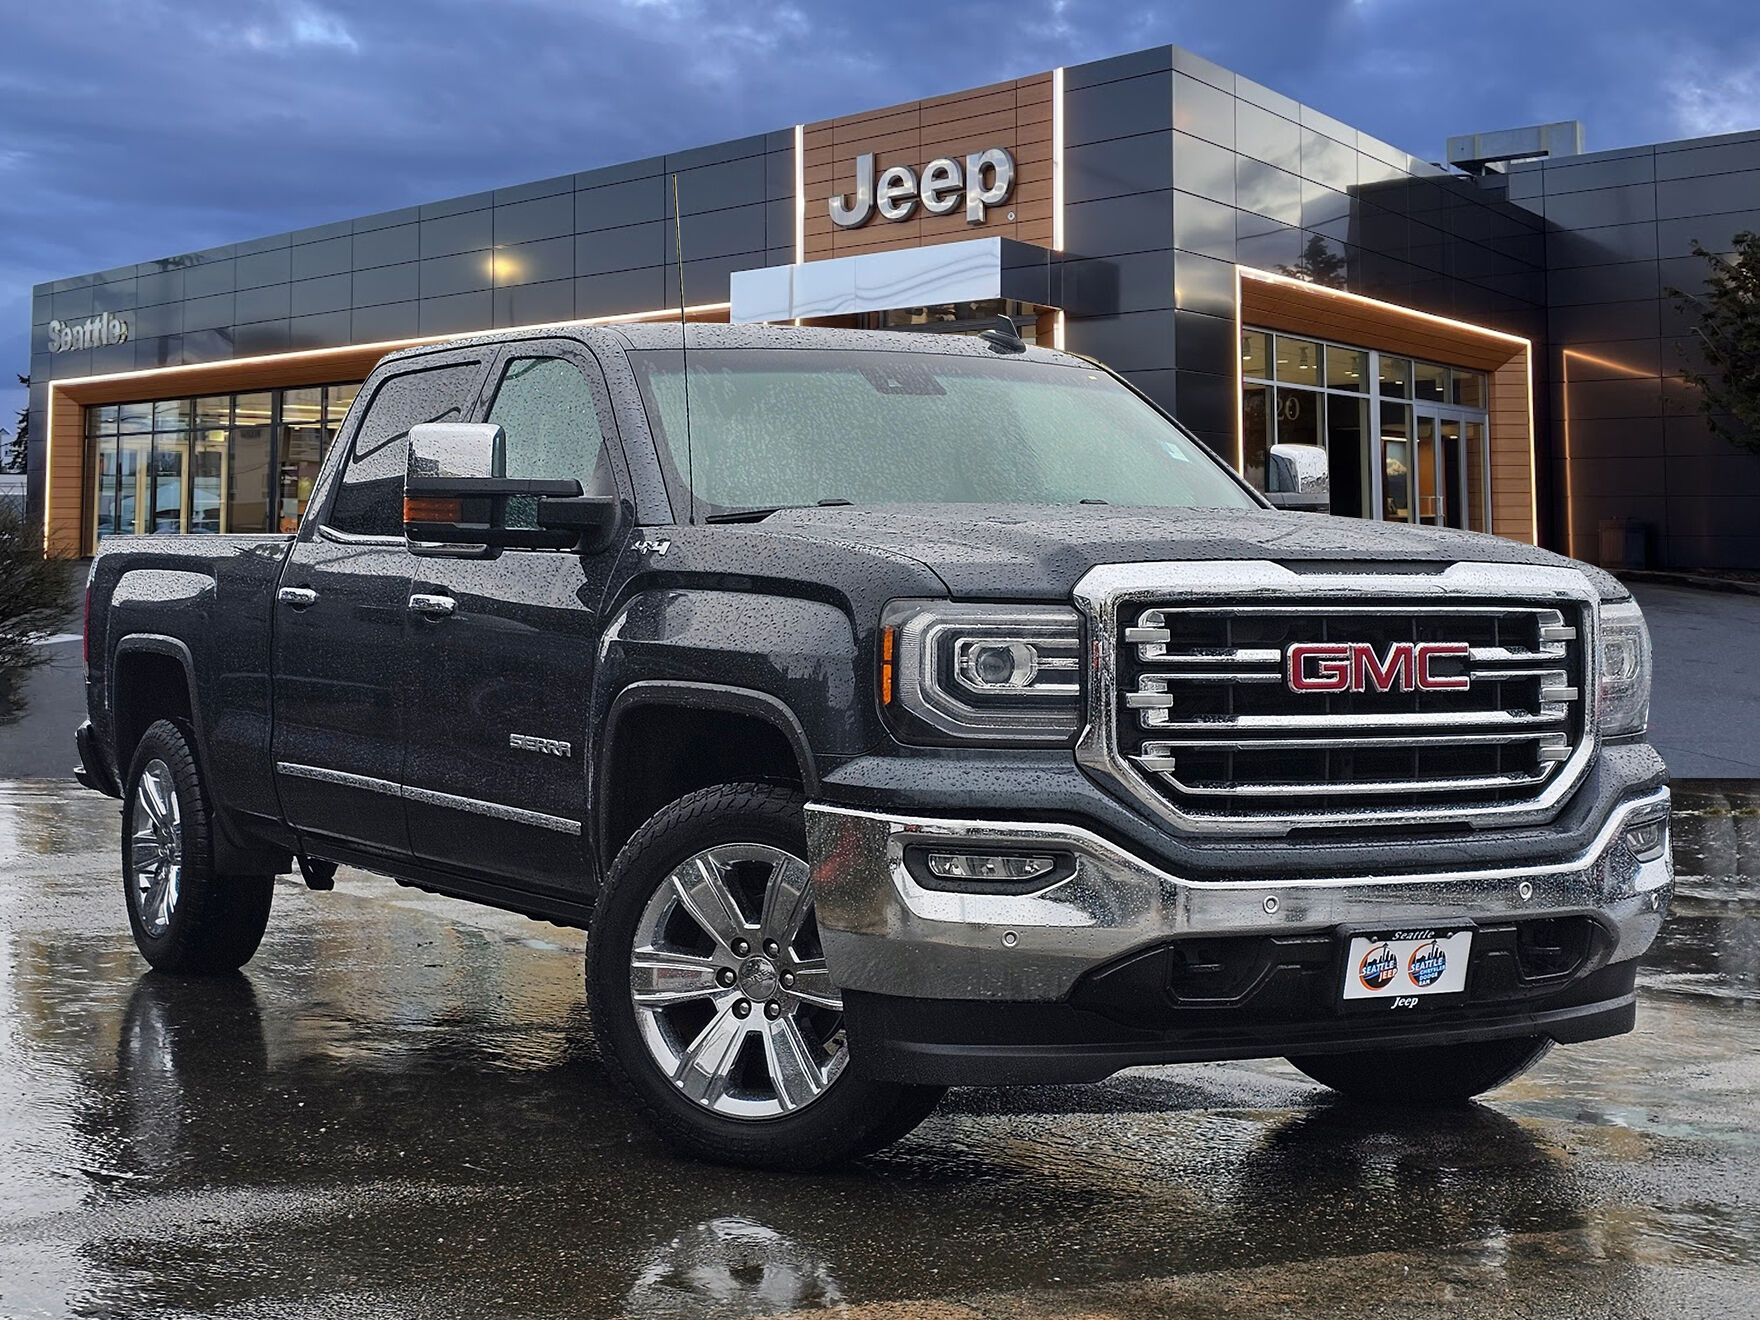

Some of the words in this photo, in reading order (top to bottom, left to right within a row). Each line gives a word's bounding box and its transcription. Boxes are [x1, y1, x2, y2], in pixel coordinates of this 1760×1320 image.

[828, 148, 1016, 228] Jeep
[48, 311, 128, 354] Seattle
[1287, 641, 1470, 693] GMC
[509, 733, 572, 757] SIERRA
[1391, 929, 1435, 941] Seattle
[1362, 960, 1394, 975] SEATTLE
[1410, 957, 1443, 972] SEATTLE
[1378, 968, 1398, 983] JEEP
[1390, 996, 1419, 1009] Jeep
